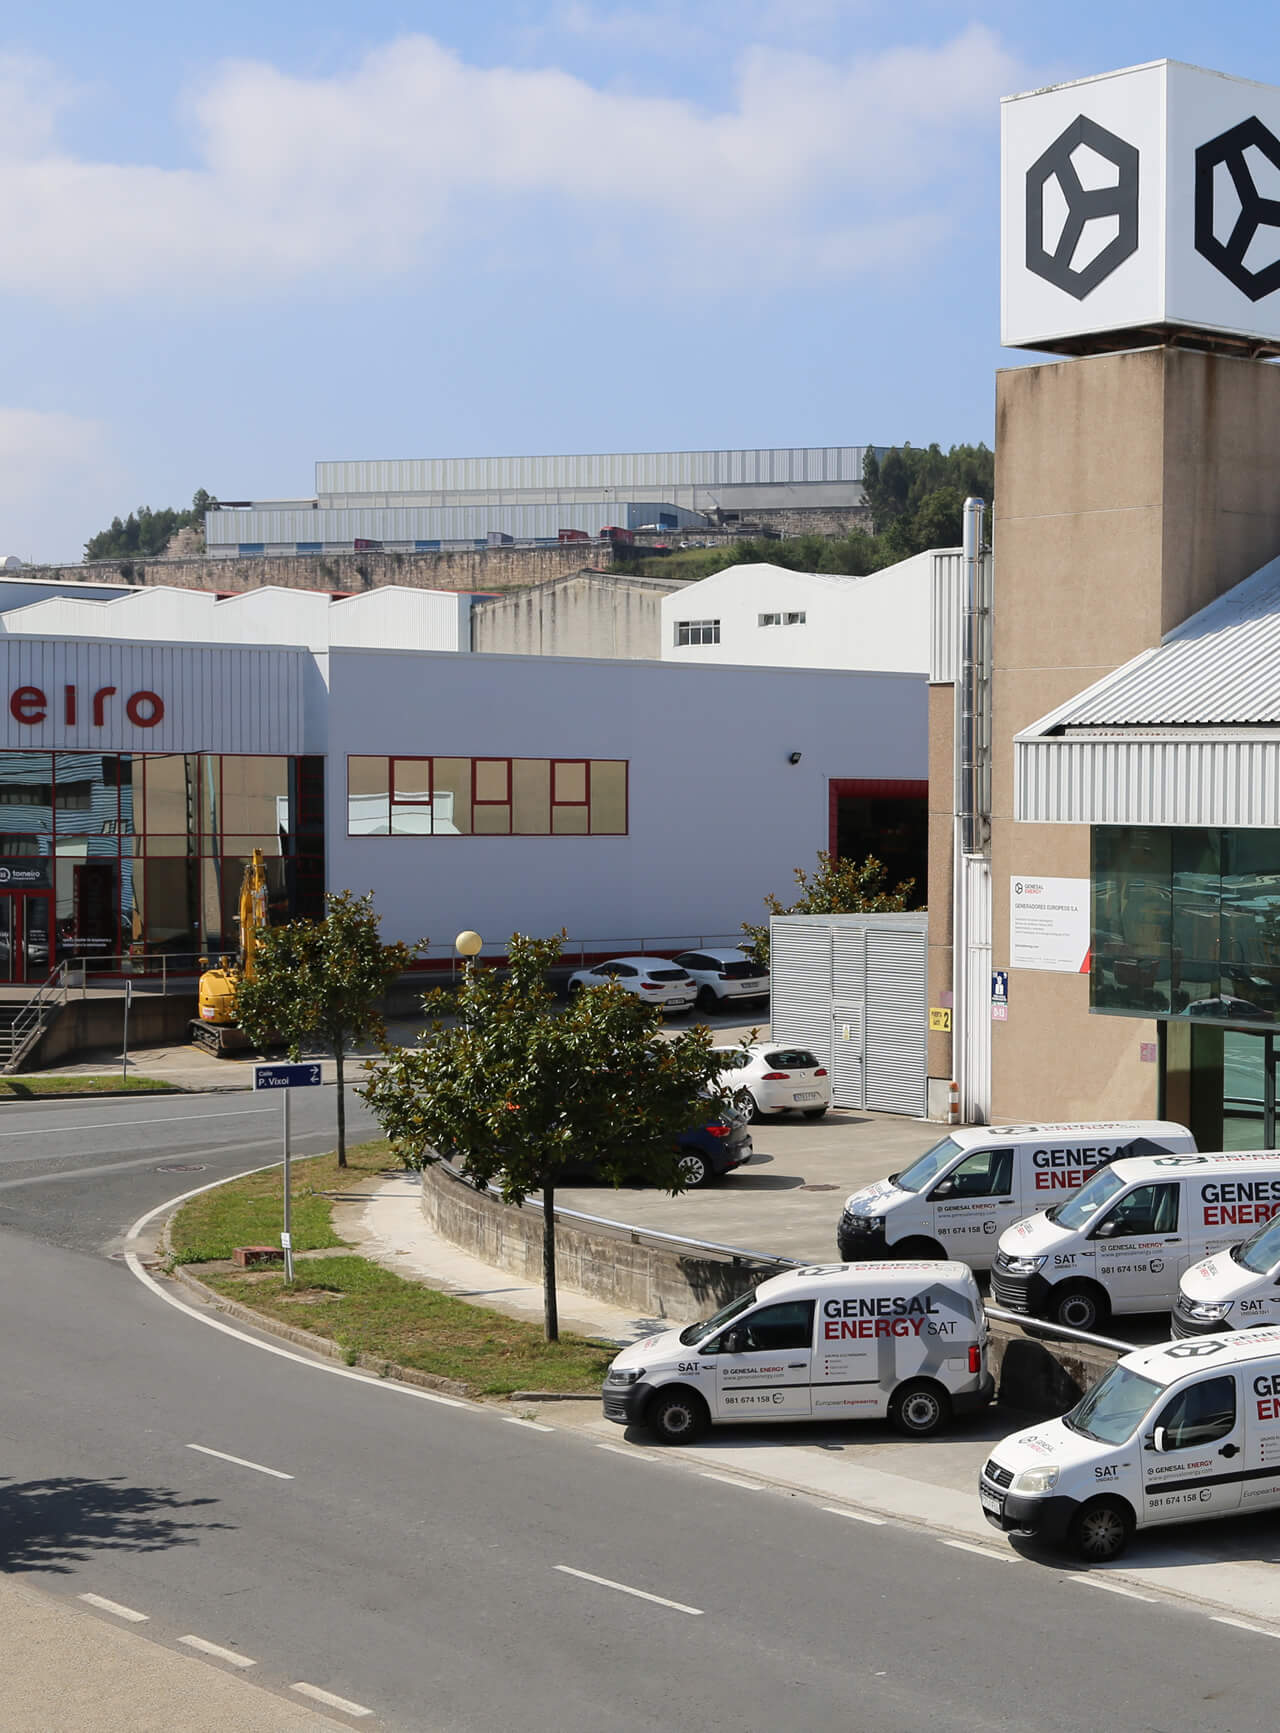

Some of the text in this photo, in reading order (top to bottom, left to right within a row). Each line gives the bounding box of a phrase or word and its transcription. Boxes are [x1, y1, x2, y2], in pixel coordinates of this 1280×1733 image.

[10, 685, 165, 728] eiro
[944, 1012, 949, 1028] 2
[1054, 1254, 1076, 1264] SAT
[824, 1296, 939, 1318] GENESAL
[1241, 1301, 1264, 1310] SAT
[824, 1317, 957, 1340] ENERGY SAT
[678, 1362, 700, 1372] SAT
[1095, 1465, 1118, 1477] SAT
[1155, 1460, 1213, 1473] GENESAL ENERGY
[1149, 1494, 1197, 1507] 981 674 158
